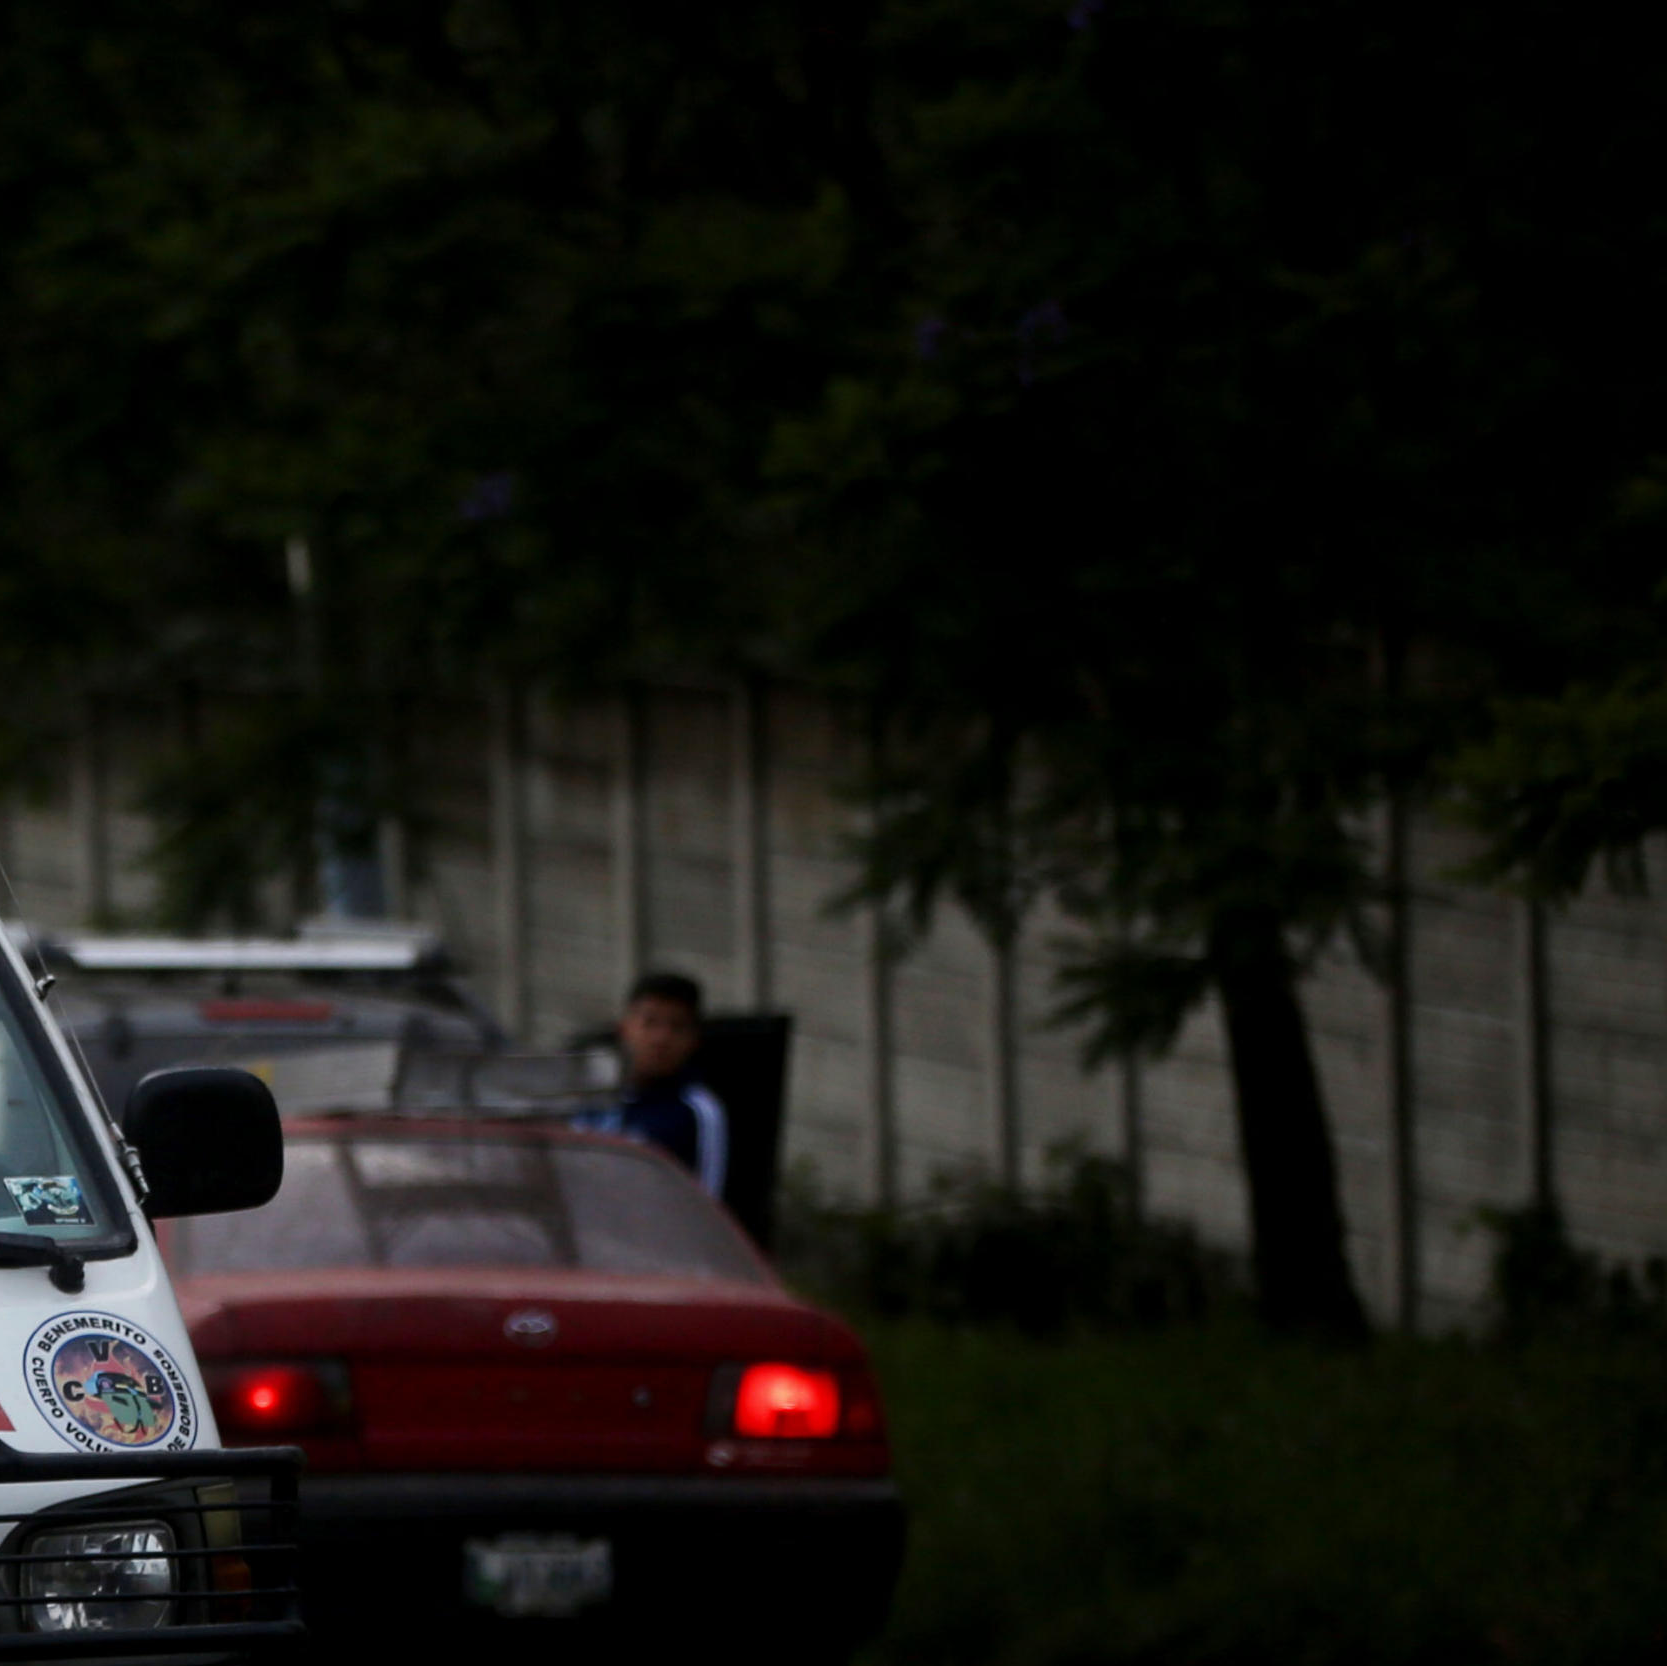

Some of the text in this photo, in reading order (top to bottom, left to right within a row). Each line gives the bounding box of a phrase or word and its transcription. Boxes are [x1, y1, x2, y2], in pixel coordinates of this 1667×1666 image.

[37, 1317, 147, 1354] BENEMERITO
[32, 1357, 64, 1419] CUERPO
[153, 1349, 191, 1438] BOMBEROS
[63, 1342, 164, 1402] C V B
